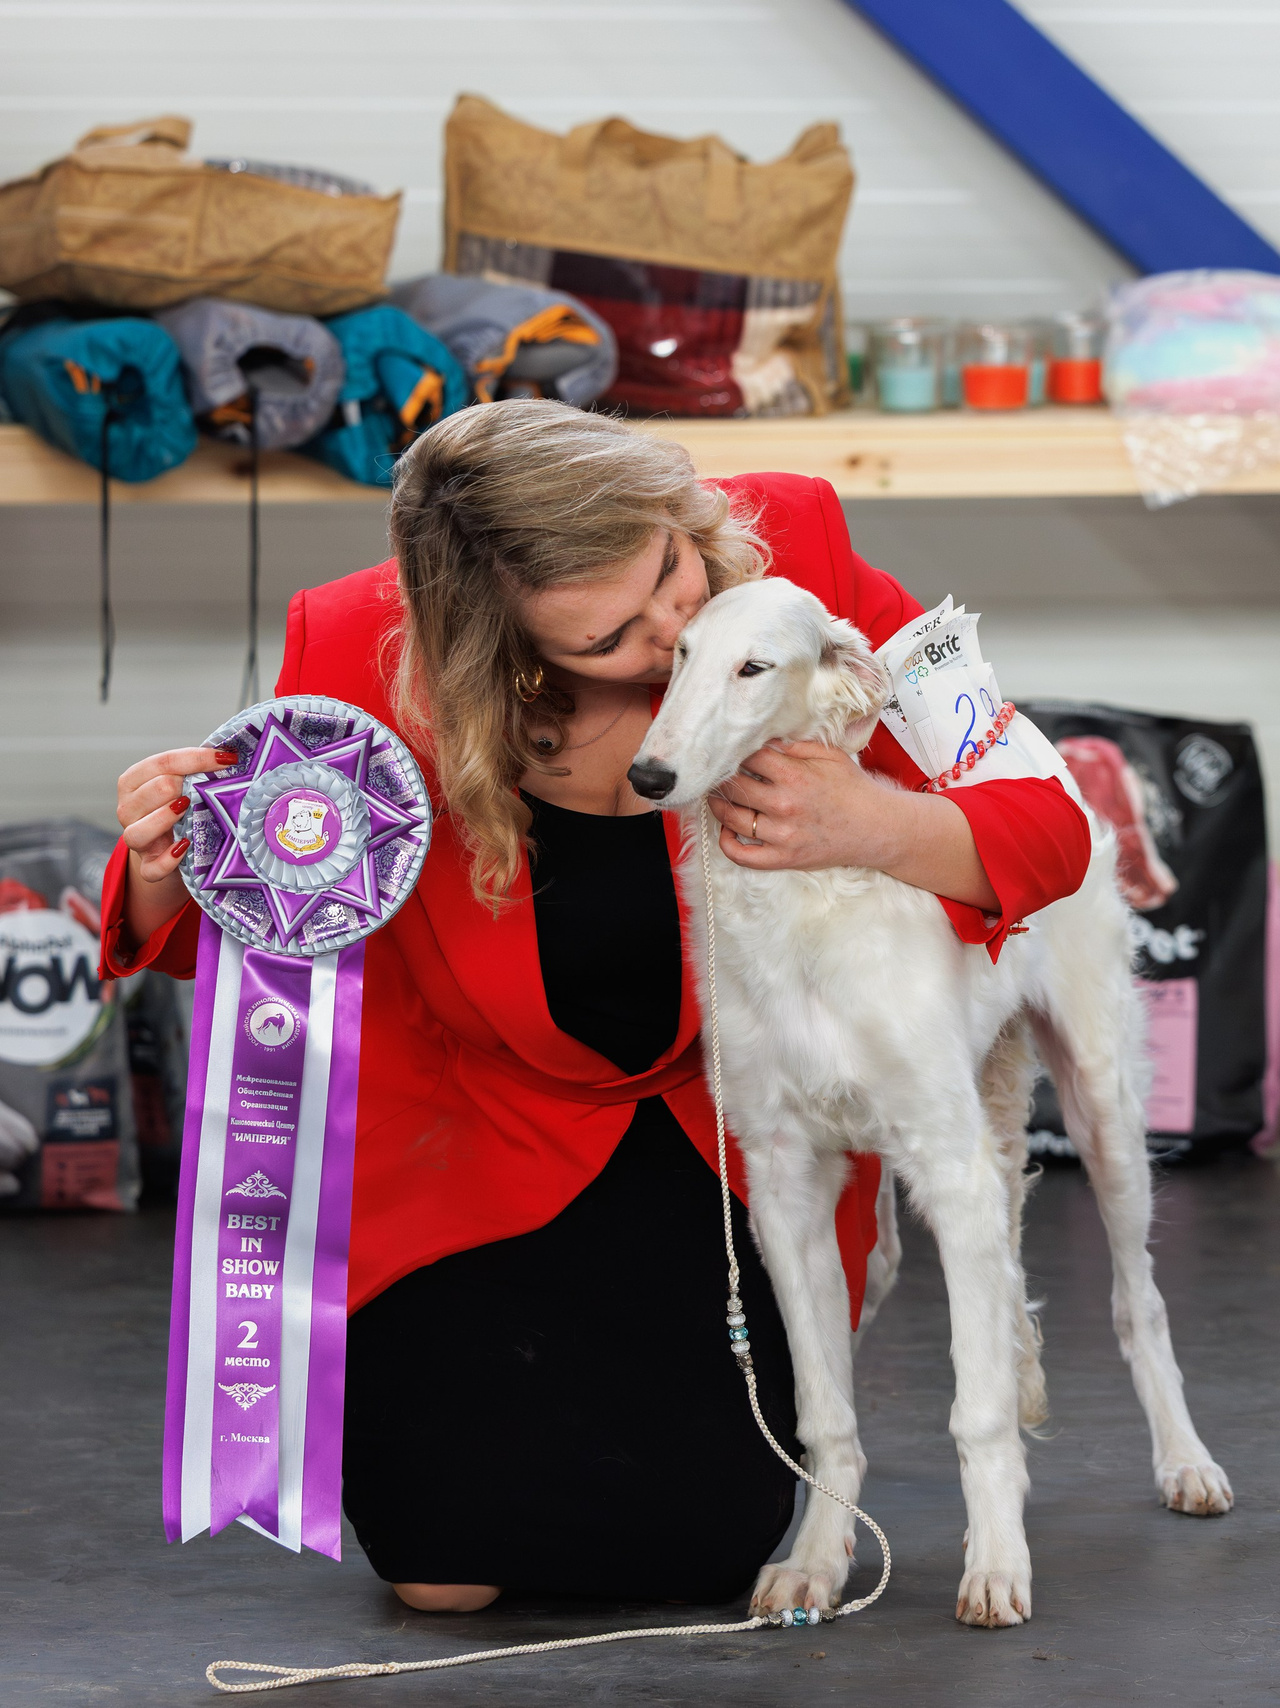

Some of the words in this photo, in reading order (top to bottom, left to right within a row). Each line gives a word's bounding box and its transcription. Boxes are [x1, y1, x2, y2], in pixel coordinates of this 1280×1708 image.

[924, 633, 961, 665] Brit
[243, 1008, 260, 1047] РОССИЙСКАЯ
[252, 996, 300, 1019] КИНОЛОГИЧЕСКАЯ
[281, 1020, 301, 1050] ФЕДЕРАЦИЯ
[236, 1074, 298, 1087] Межрегиональная
[237, 1087, 294, 1099] Общественная
[240, 1100, 288, 1112] Организация
[230, 1117, 275, 1128] Кинологический
[275, 1120, 296, 1132] Центр
[231, 1132, 292, 1146] "ИМПЕРИЯ"
[226, 1213, 281, 1232] BEST
[240, 1237, 263, 1253] IN
[221, 1258, 281, 1276] SHOW
[225, 1283, 275, 1300] BABY
[237, 1320, 260, 1349] 2
[224, 1356, 271, 1368] место
[219, 1433, 228, 1443] г.
[230, 1433, 271, 1444] Москва
